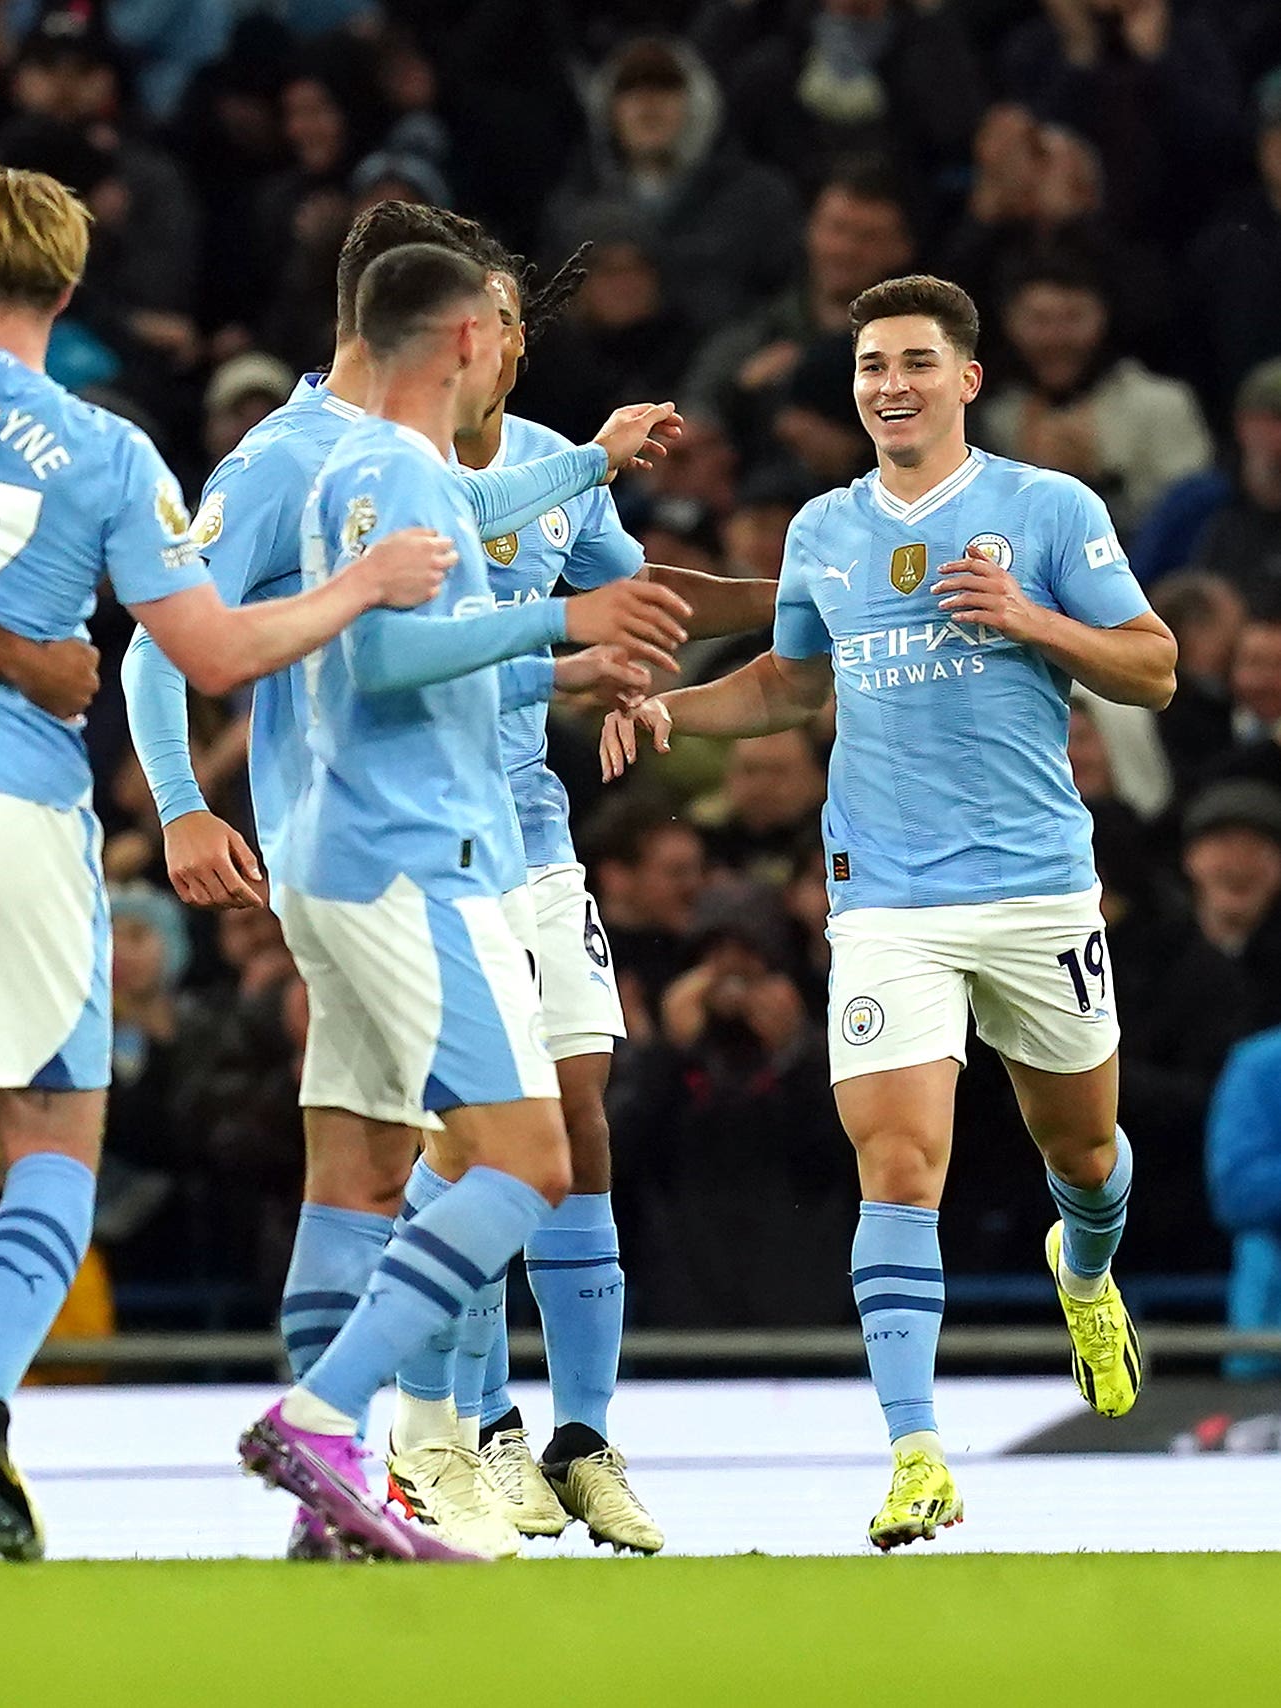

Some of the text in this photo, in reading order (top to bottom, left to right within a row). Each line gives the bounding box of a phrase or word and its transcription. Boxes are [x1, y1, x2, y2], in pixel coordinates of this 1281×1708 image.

[857, 654, 986, 692] AIRWAYS
[1056, 929, 1106, 1013] 19
[864, 1330, 909, 1343] CITY
